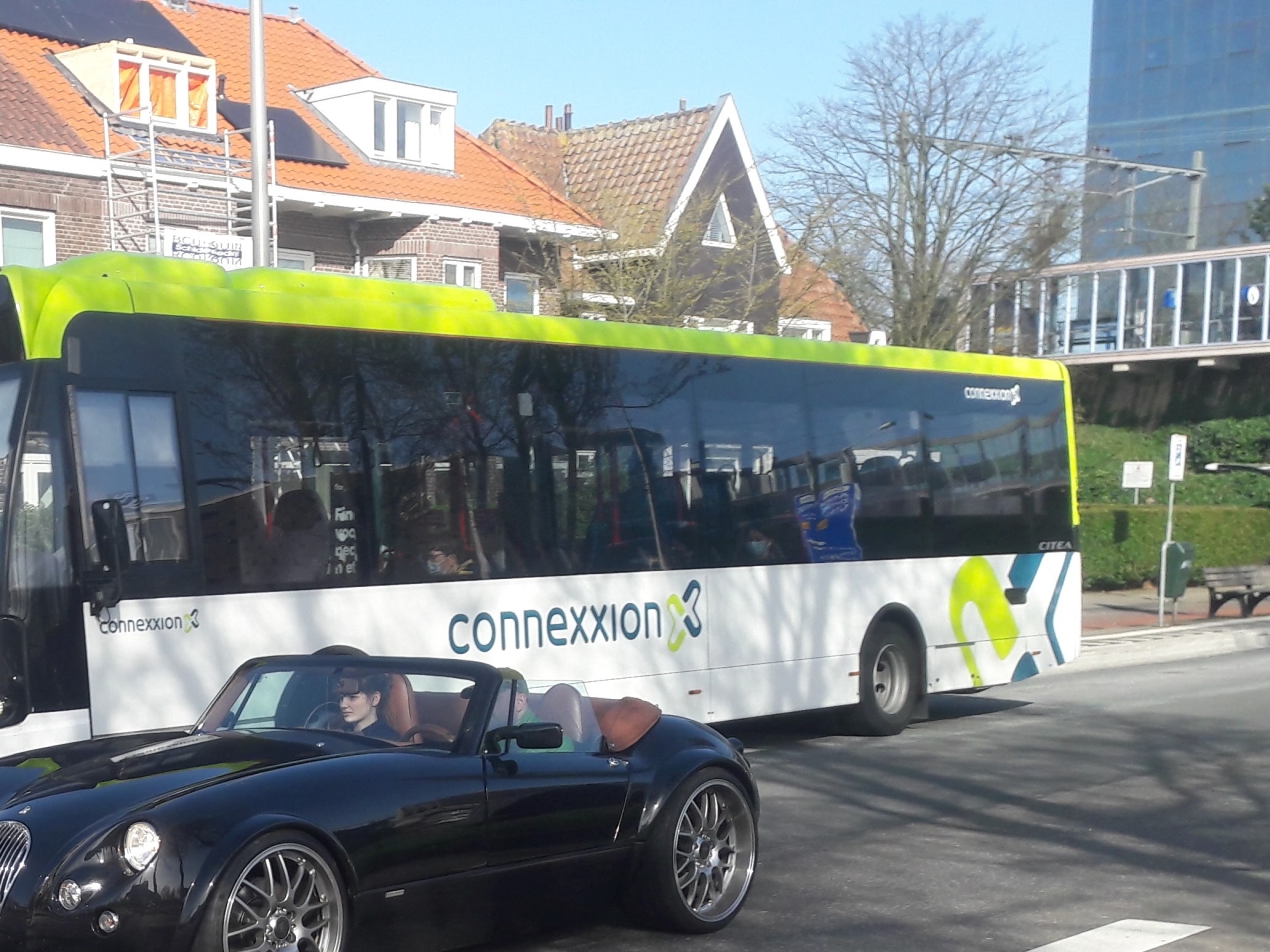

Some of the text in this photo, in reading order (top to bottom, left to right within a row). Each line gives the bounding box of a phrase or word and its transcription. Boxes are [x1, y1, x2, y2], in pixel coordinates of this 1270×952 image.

[1038, 540, 1073, 551] CITEA
[99, 616, 183, 635] connexxion
[448, 601, 662, 655] connexxion
